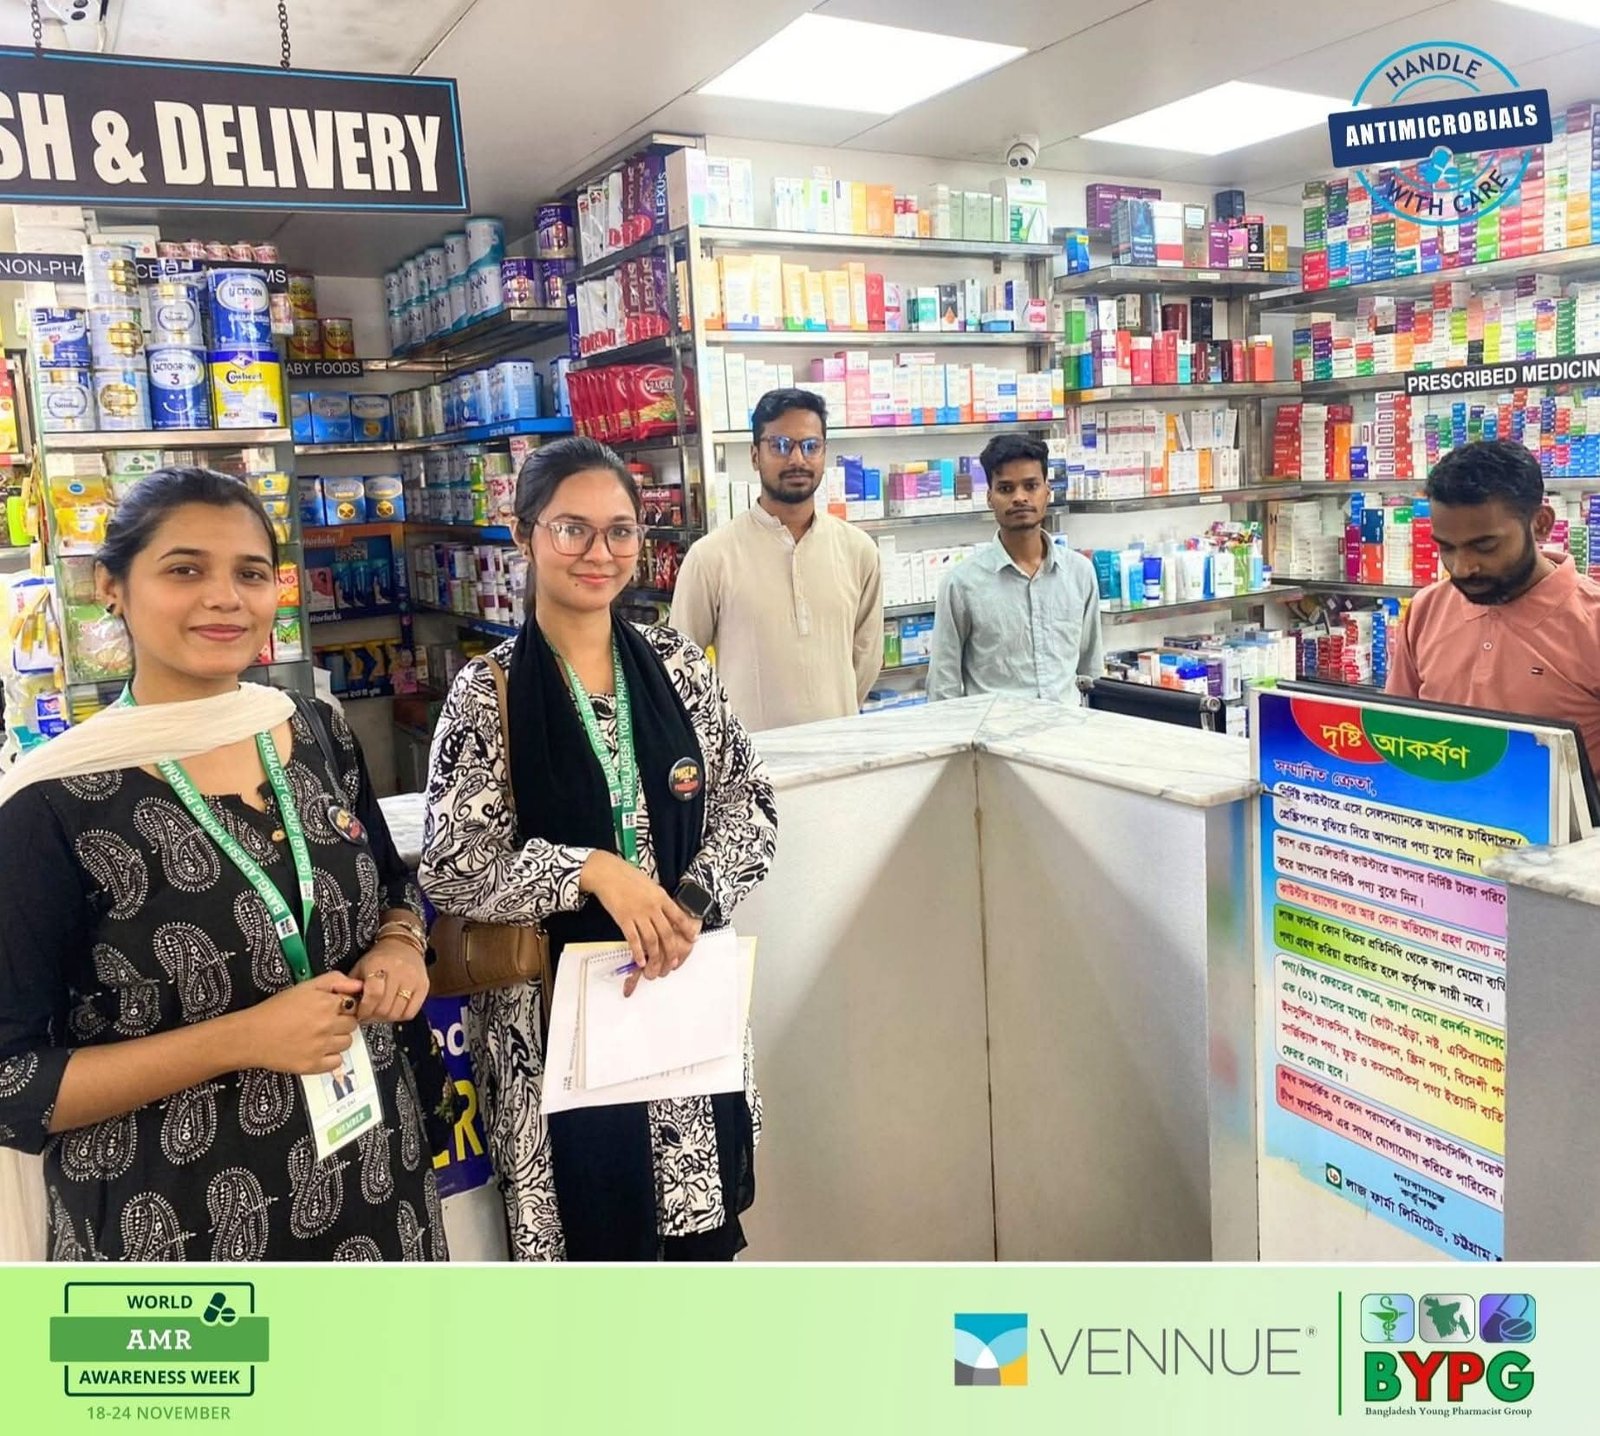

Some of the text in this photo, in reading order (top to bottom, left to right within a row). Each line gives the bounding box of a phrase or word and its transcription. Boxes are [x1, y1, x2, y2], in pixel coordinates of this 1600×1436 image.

[91, 110, 146, 184] &
[154, 101, 440, 192] DELIVERY
[656, 171, 667, 215] LEXUS
[170, 373, 180, 385] 3
[286, 362, 360, 374] ABY FOODS
[1407, 358, 1600, 392] PRESCRIBED MEDICIN
[617, 701, 632, 740] YOUNG
[1320, 722, 1470, 768] দৃষ্টি আকর্ষণ
[261, 730, 288, 794] HARMACIST
[281, 792, 301, 833] GROUP
[619, 741, 634, 808] BANGLADESH
[191, 799, 228, 847] YOUNG
[1343, 802, 1362, 814] এসে
[1426, 820, 1464, 837] আপনার
[1350, 823, 1369, 840] দিয়ে
[1372, 832, 1407, 849] আপনার
[1411, 841, 1429, 855] পণ্য
[226, 840, 285, 915] BANGLADESH
[1296, 860, 1328, 879] আপনার
[1330, 868, 1354, 886] নির্দিষ্ট
[1357, 880, 1375, 893] পণ্য
[1400, 888, 1418, 907] নিন
[1391, 865, 1425, 883] আপনার
[1427, 872, 1453, 890] নির্দিষ্ট
[1455, 880, 1477, 898] টাকা
[1359, 907, 1375, 921] আর
[1378, 913, 1398, 928] কোন
[1405, 951, 1429, 966] থেকে
[1431, 958, 1453, 975] ক্যাশ
[1457, 968, 1484, 985] মেমো
[1463, 993, 1484, 1012] নহে
